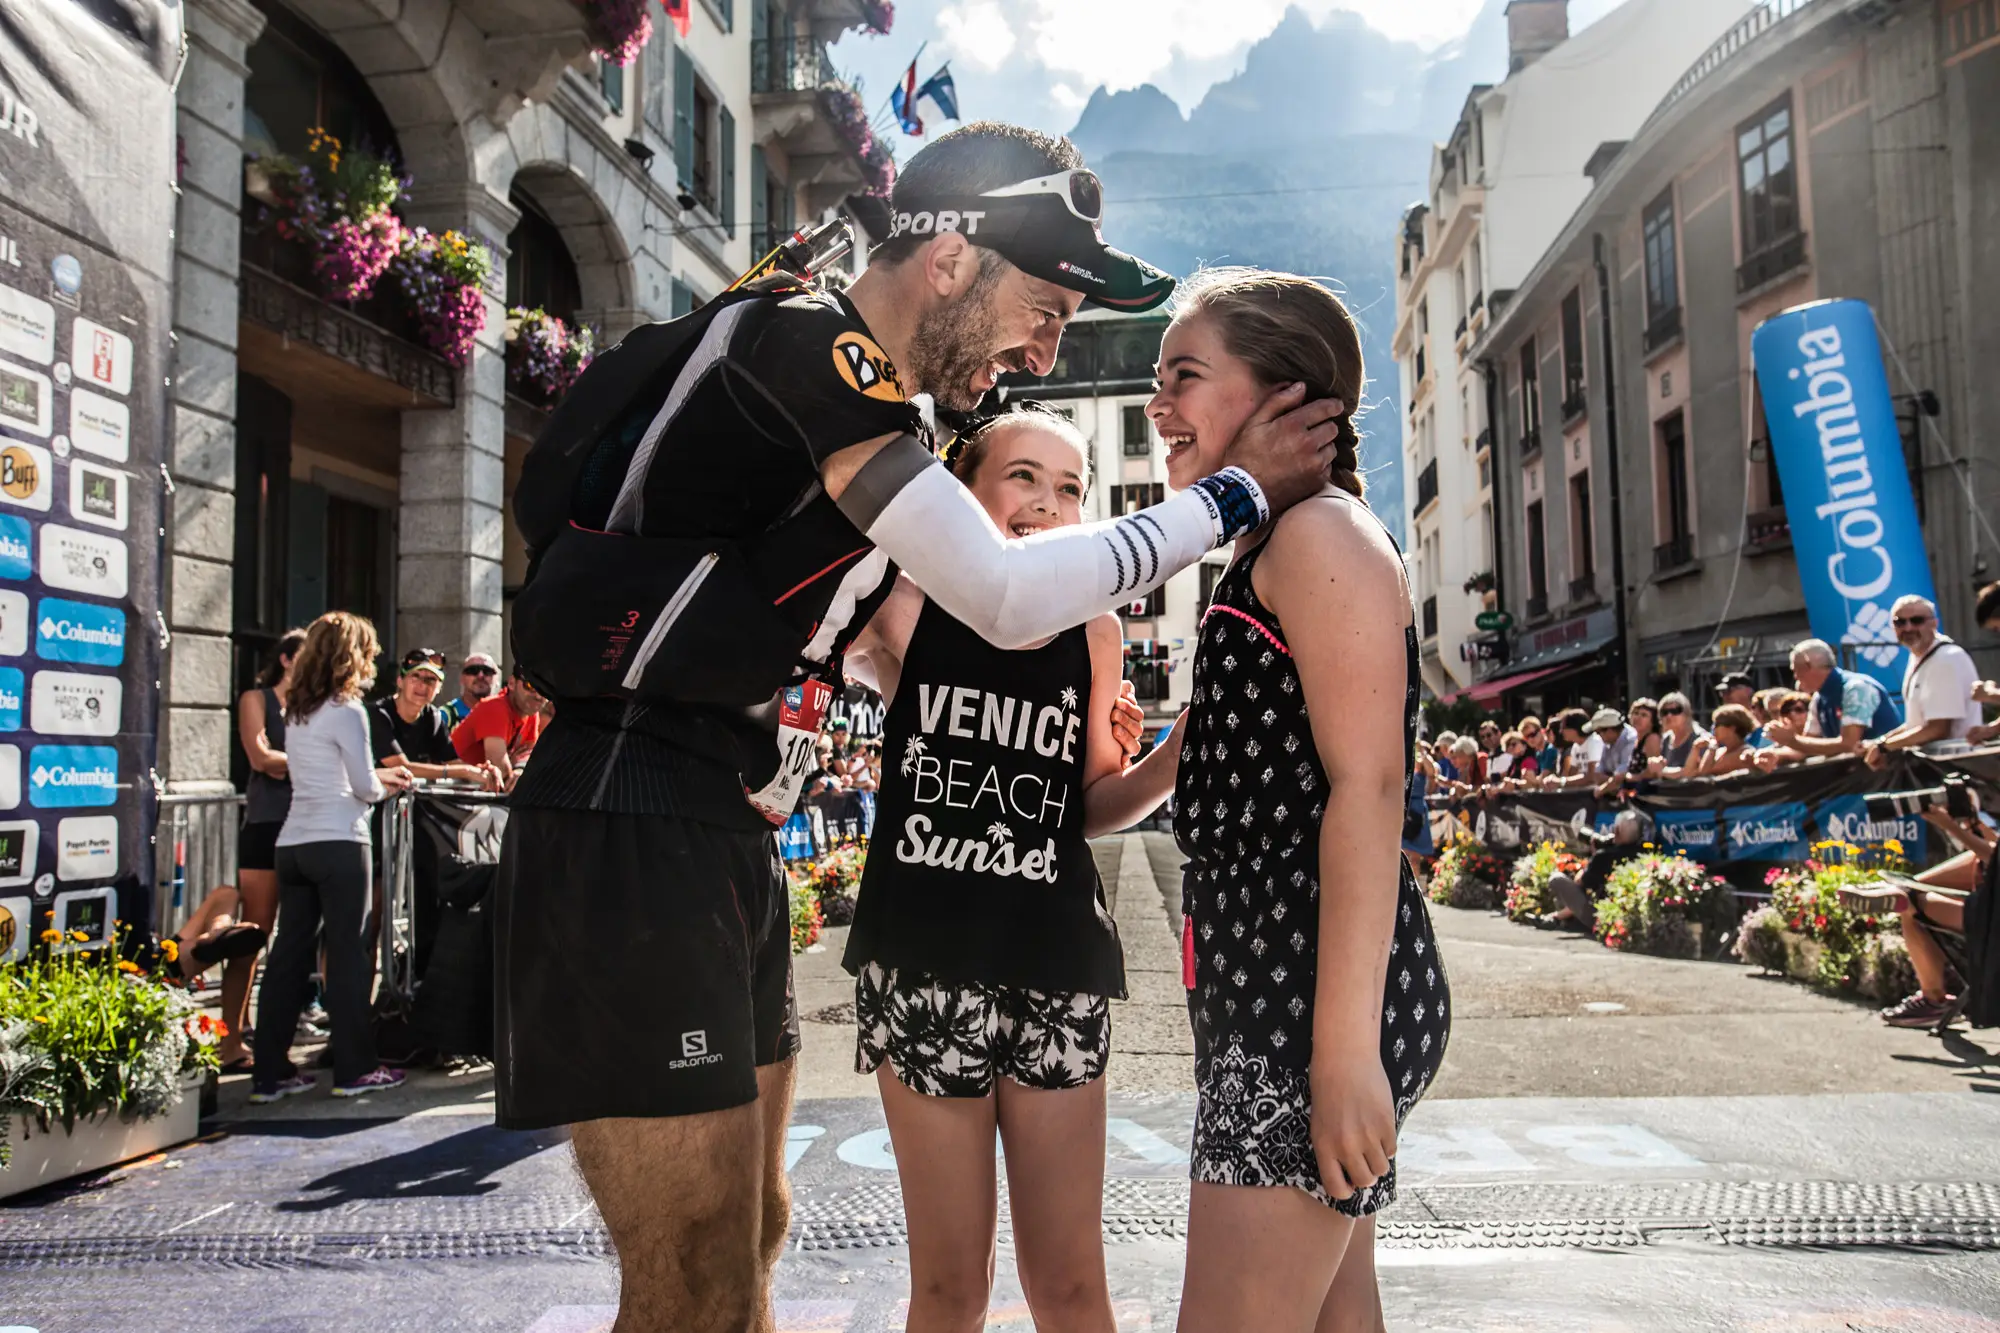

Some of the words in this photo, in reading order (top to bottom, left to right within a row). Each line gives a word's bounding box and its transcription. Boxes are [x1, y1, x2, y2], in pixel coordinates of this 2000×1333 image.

[1069, 268, 1106, 284] SWITZERLAND
[1788, 324, 1893, 600] Columbia
[621, 611, 640, 628] 3
[56, 620, 122, 646] Columbia
[919, 684, 1081, 764] VENICE
[49, 766, 115, 787] Columbia
[914, 756, 1068, 829] BEACH
[896, 813, 1058, 884] Sunset
[669, 1053, 723, 1069] salomon
